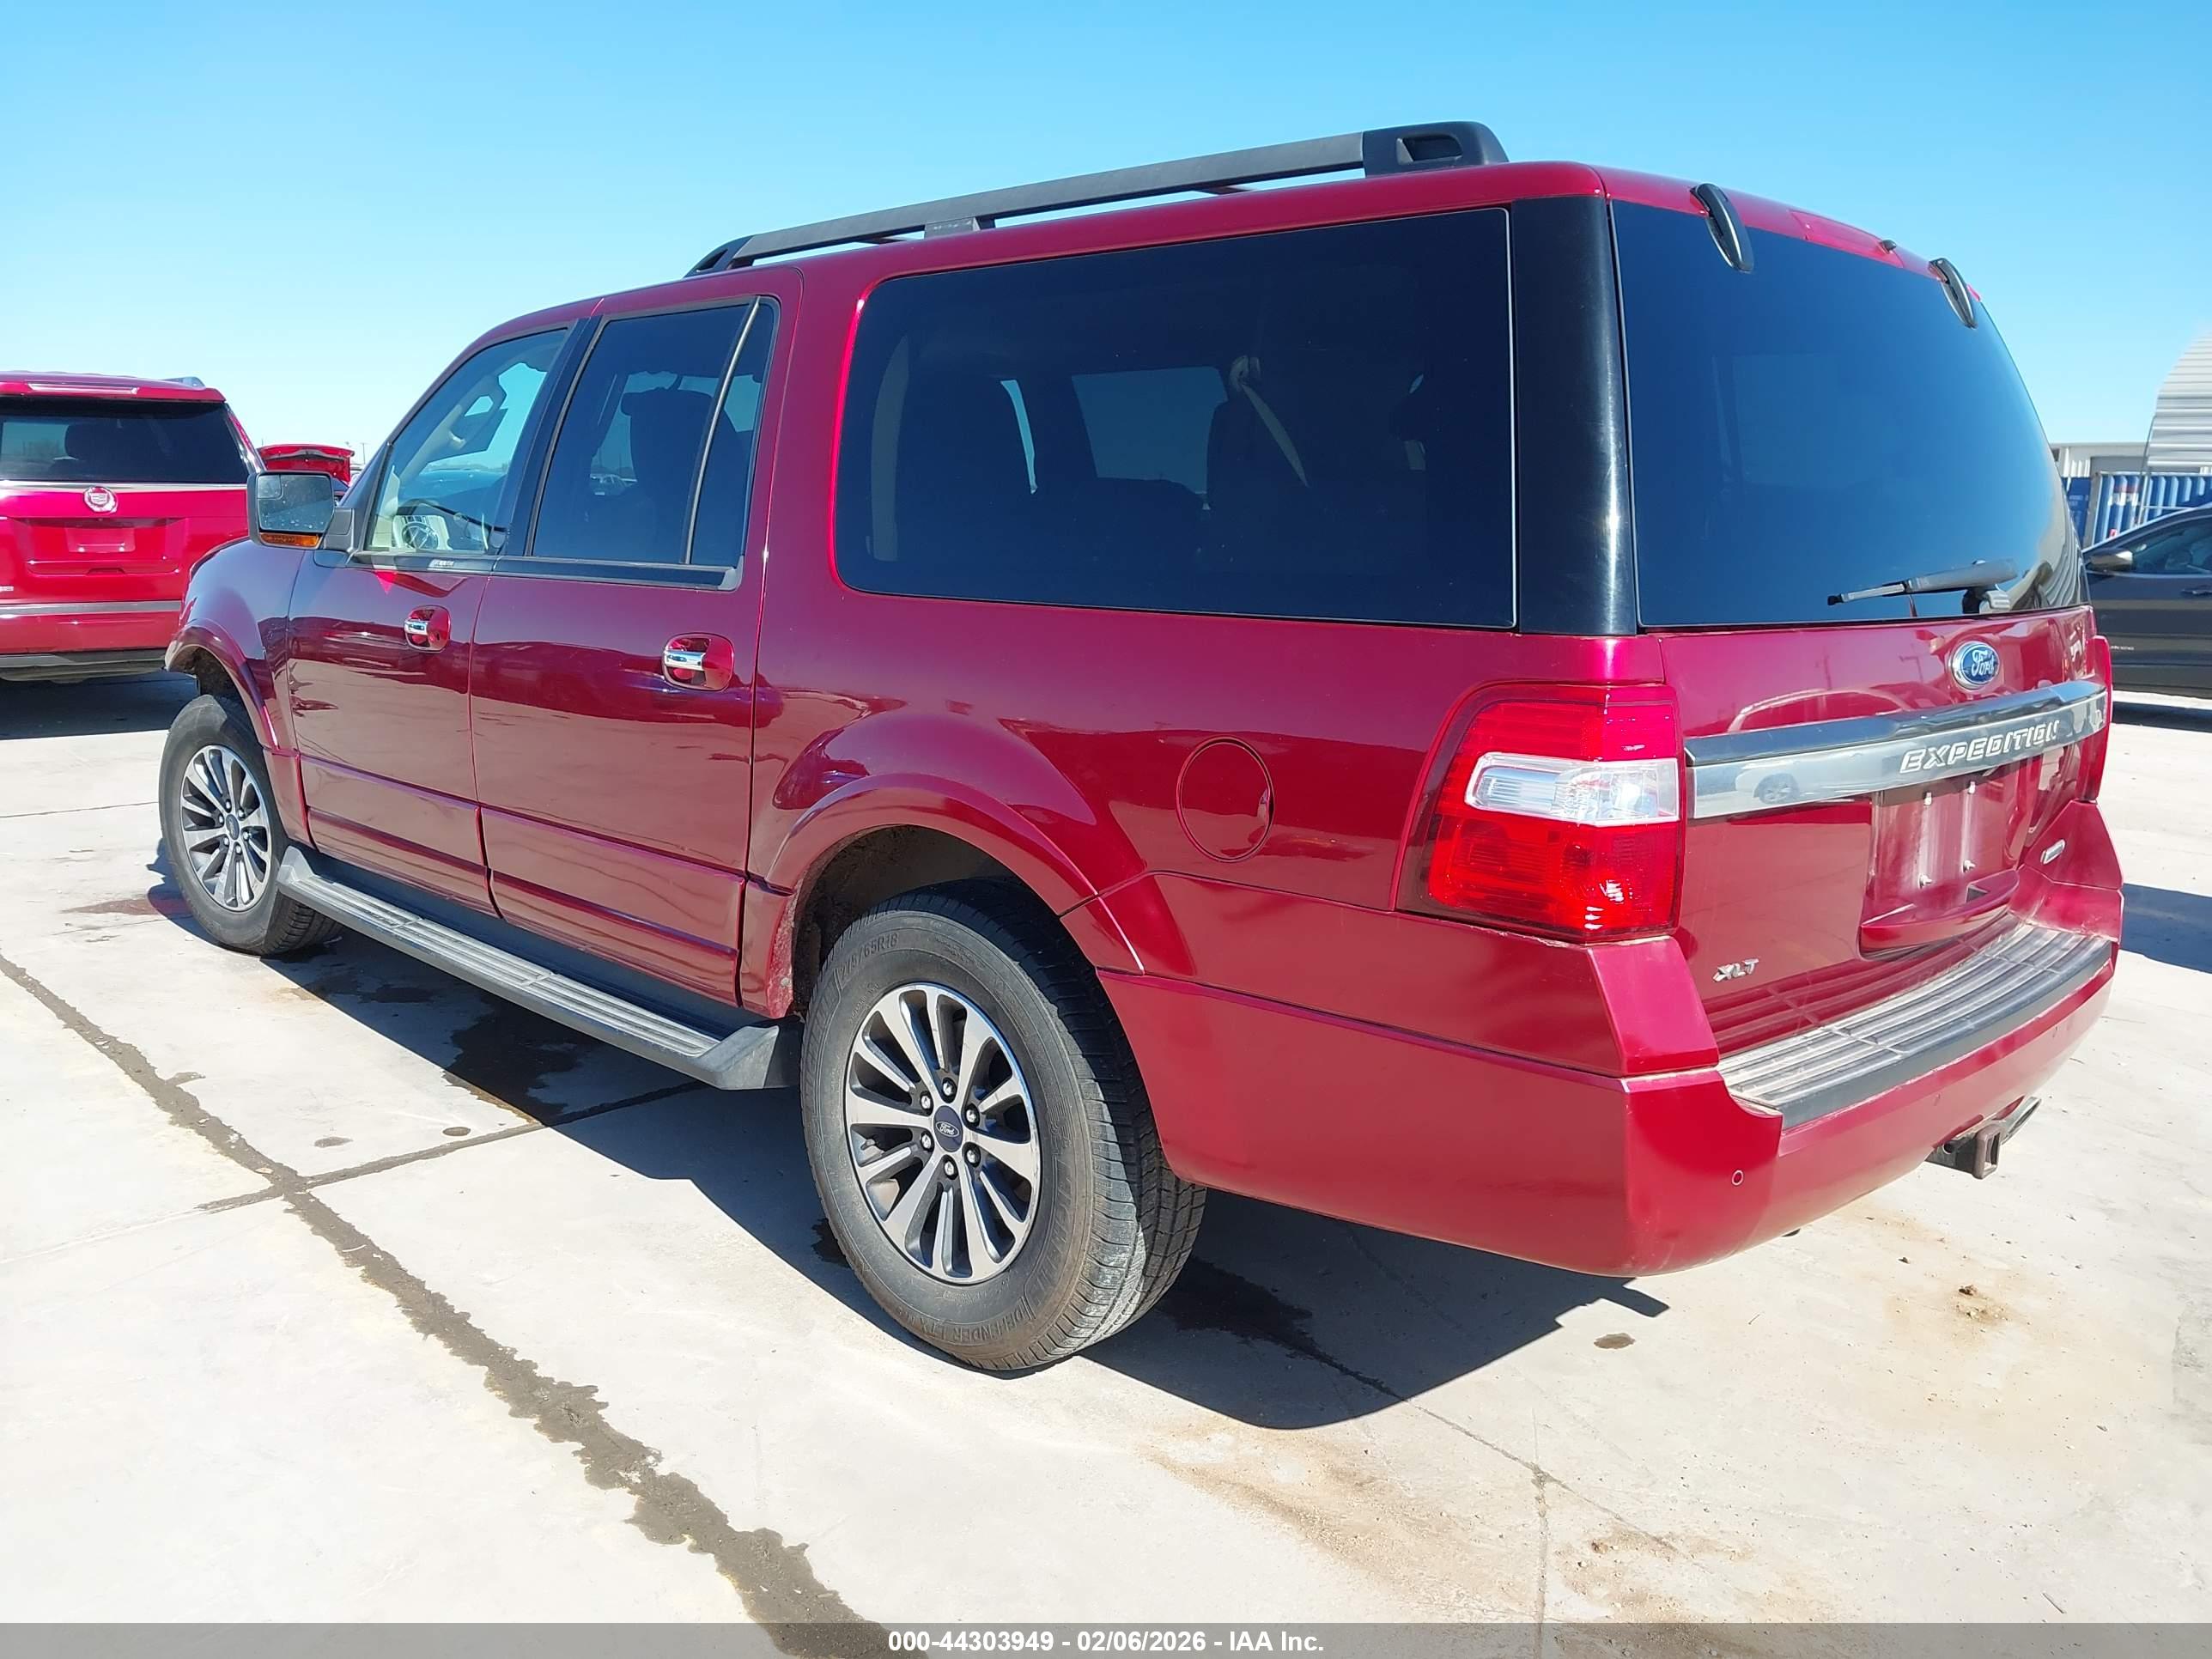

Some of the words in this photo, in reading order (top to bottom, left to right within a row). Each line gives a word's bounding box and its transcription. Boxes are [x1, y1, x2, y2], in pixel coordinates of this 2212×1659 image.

[1971, 649, 1997, 676] Ford
[1899, 720, 2060, 774] EXPEDITION
[1712, 957, 1759, 982] XLT
